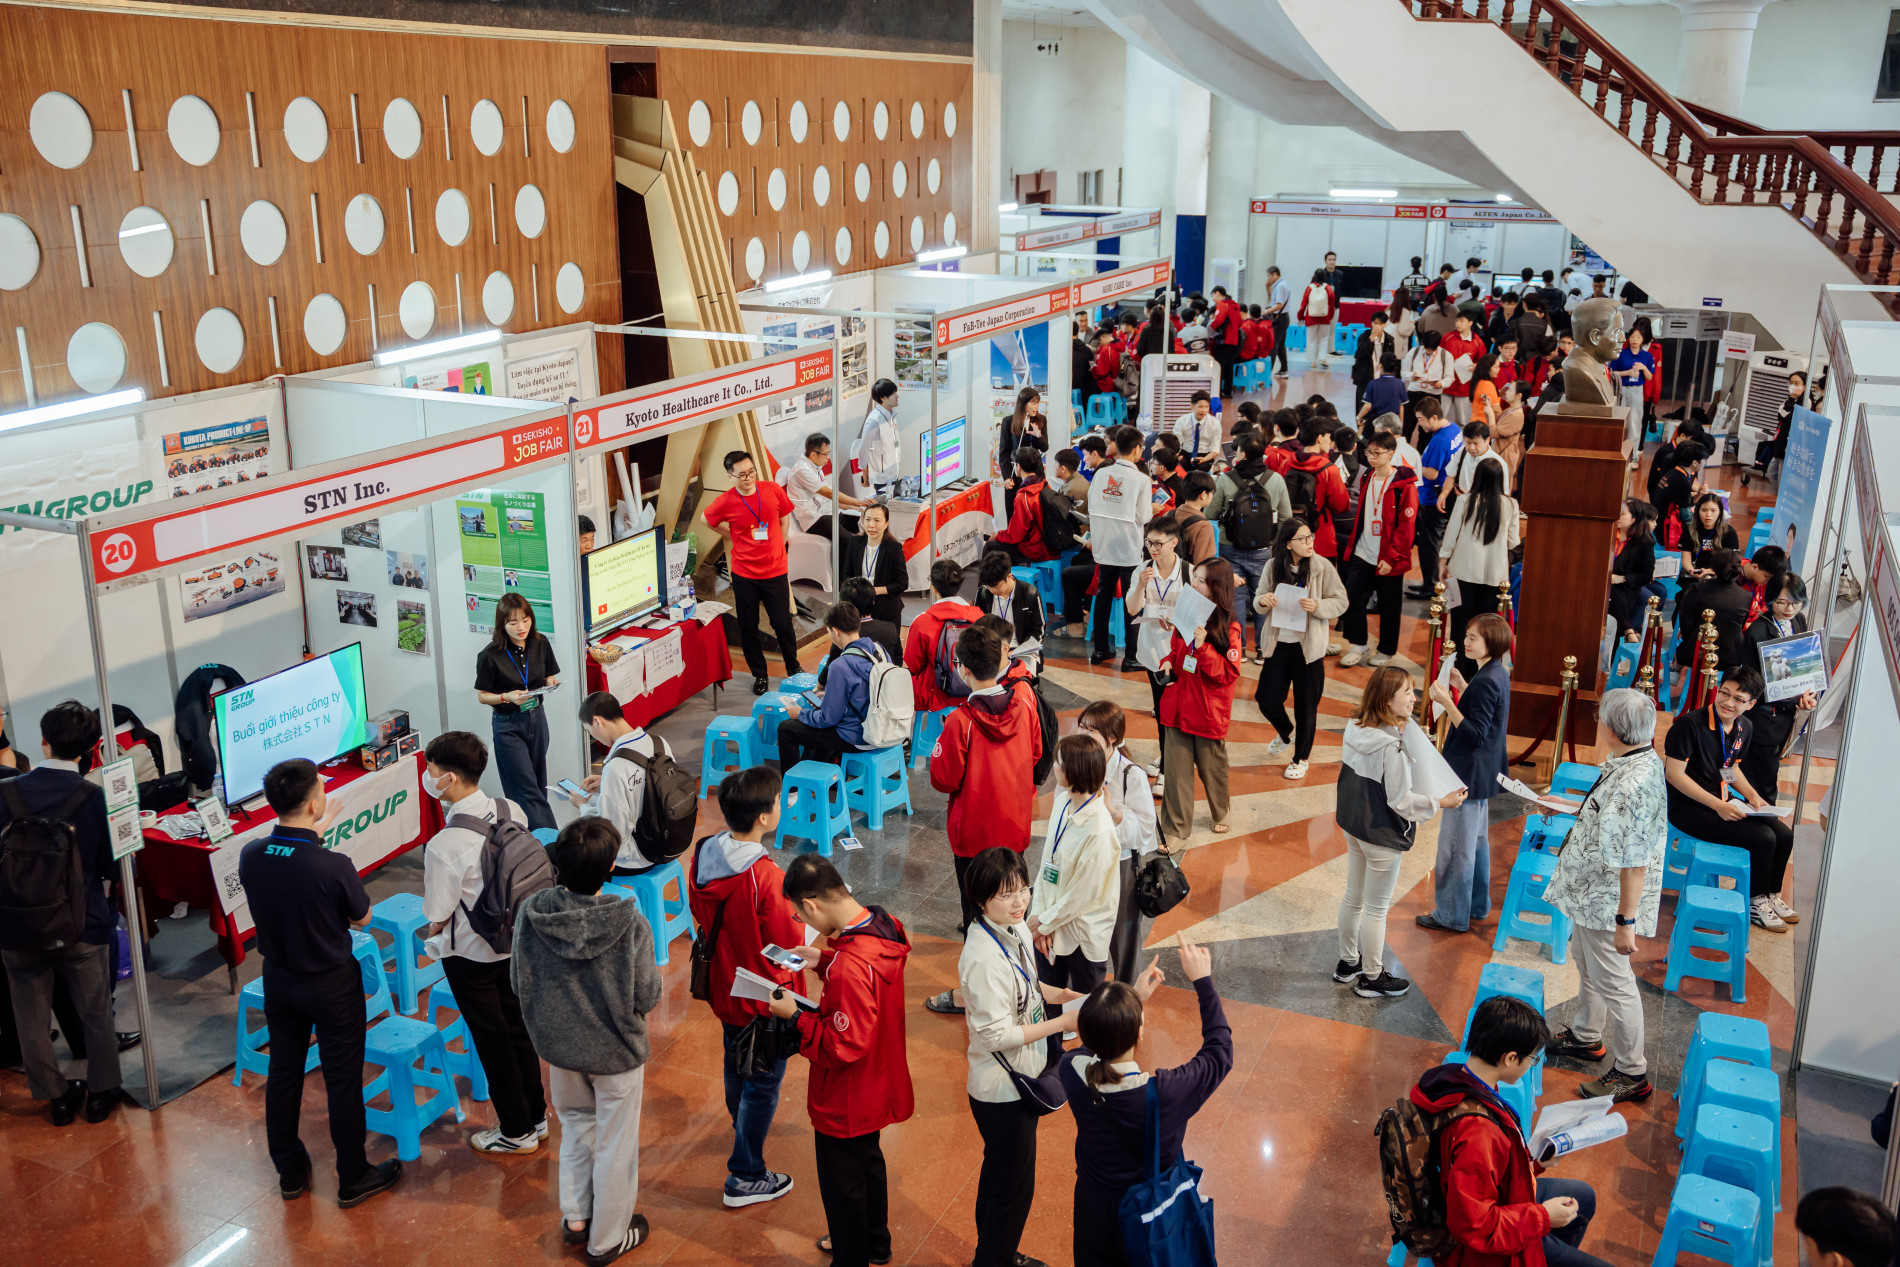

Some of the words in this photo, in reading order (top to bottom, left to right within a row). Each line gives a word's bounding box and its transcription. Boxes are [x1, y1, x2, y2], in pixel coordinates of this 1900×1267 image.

[1052, 300, 1060, 311] JOB
[1060, 298, 1068, 307] FAIR
[938, 327, 946, 338] 22
[986, 315, 1004, 329] Japan
[1004, 305, 1036, 321] Corporation
[542, 362, 556, 372] Kyoto
[557, 357, 574, 368] Japan?
[805, 356, 825, 368] SEKISHO
[800, 369, 815, 383] JOB
[815, 365, 830, 377] FAIR
[577, 421, 591, 438] 21
[626, 409, 659, 429] Kyoto
[662, 393, 720, 417] Healthcare
[722, 387, 731, 400] It
[734, 383, 752, 398] Co.,
[754, 376, 773, 391] Ltd.
[183, 433, 206, 445] KUBOTA
[522, 426, 553, 442] SEKISHO
[513, 443, 538, 463] JOB
[539, 436, 563, 454] FAIR
[503, 500, 537, 508] モノづくり企業
[103, 540, 134, 566] 20
[304, 486, 348, 515] STN
[354, 479, 390, 501] Inc.
[231, 689, 254, 706] STN
[231, 698, 255, 712] GROUP
[233, 722, 255, 743] Buổi
[258, 715, 277, 735] giới
[279, 706, 304, 723] thiệu
[306, 697, 329, 713] công
[331, 691, 341, 703] ty
[628, 769, 642, 791] The
[321, 789, 408, 850] GROUP
[264, 844, 295, 857] STN
